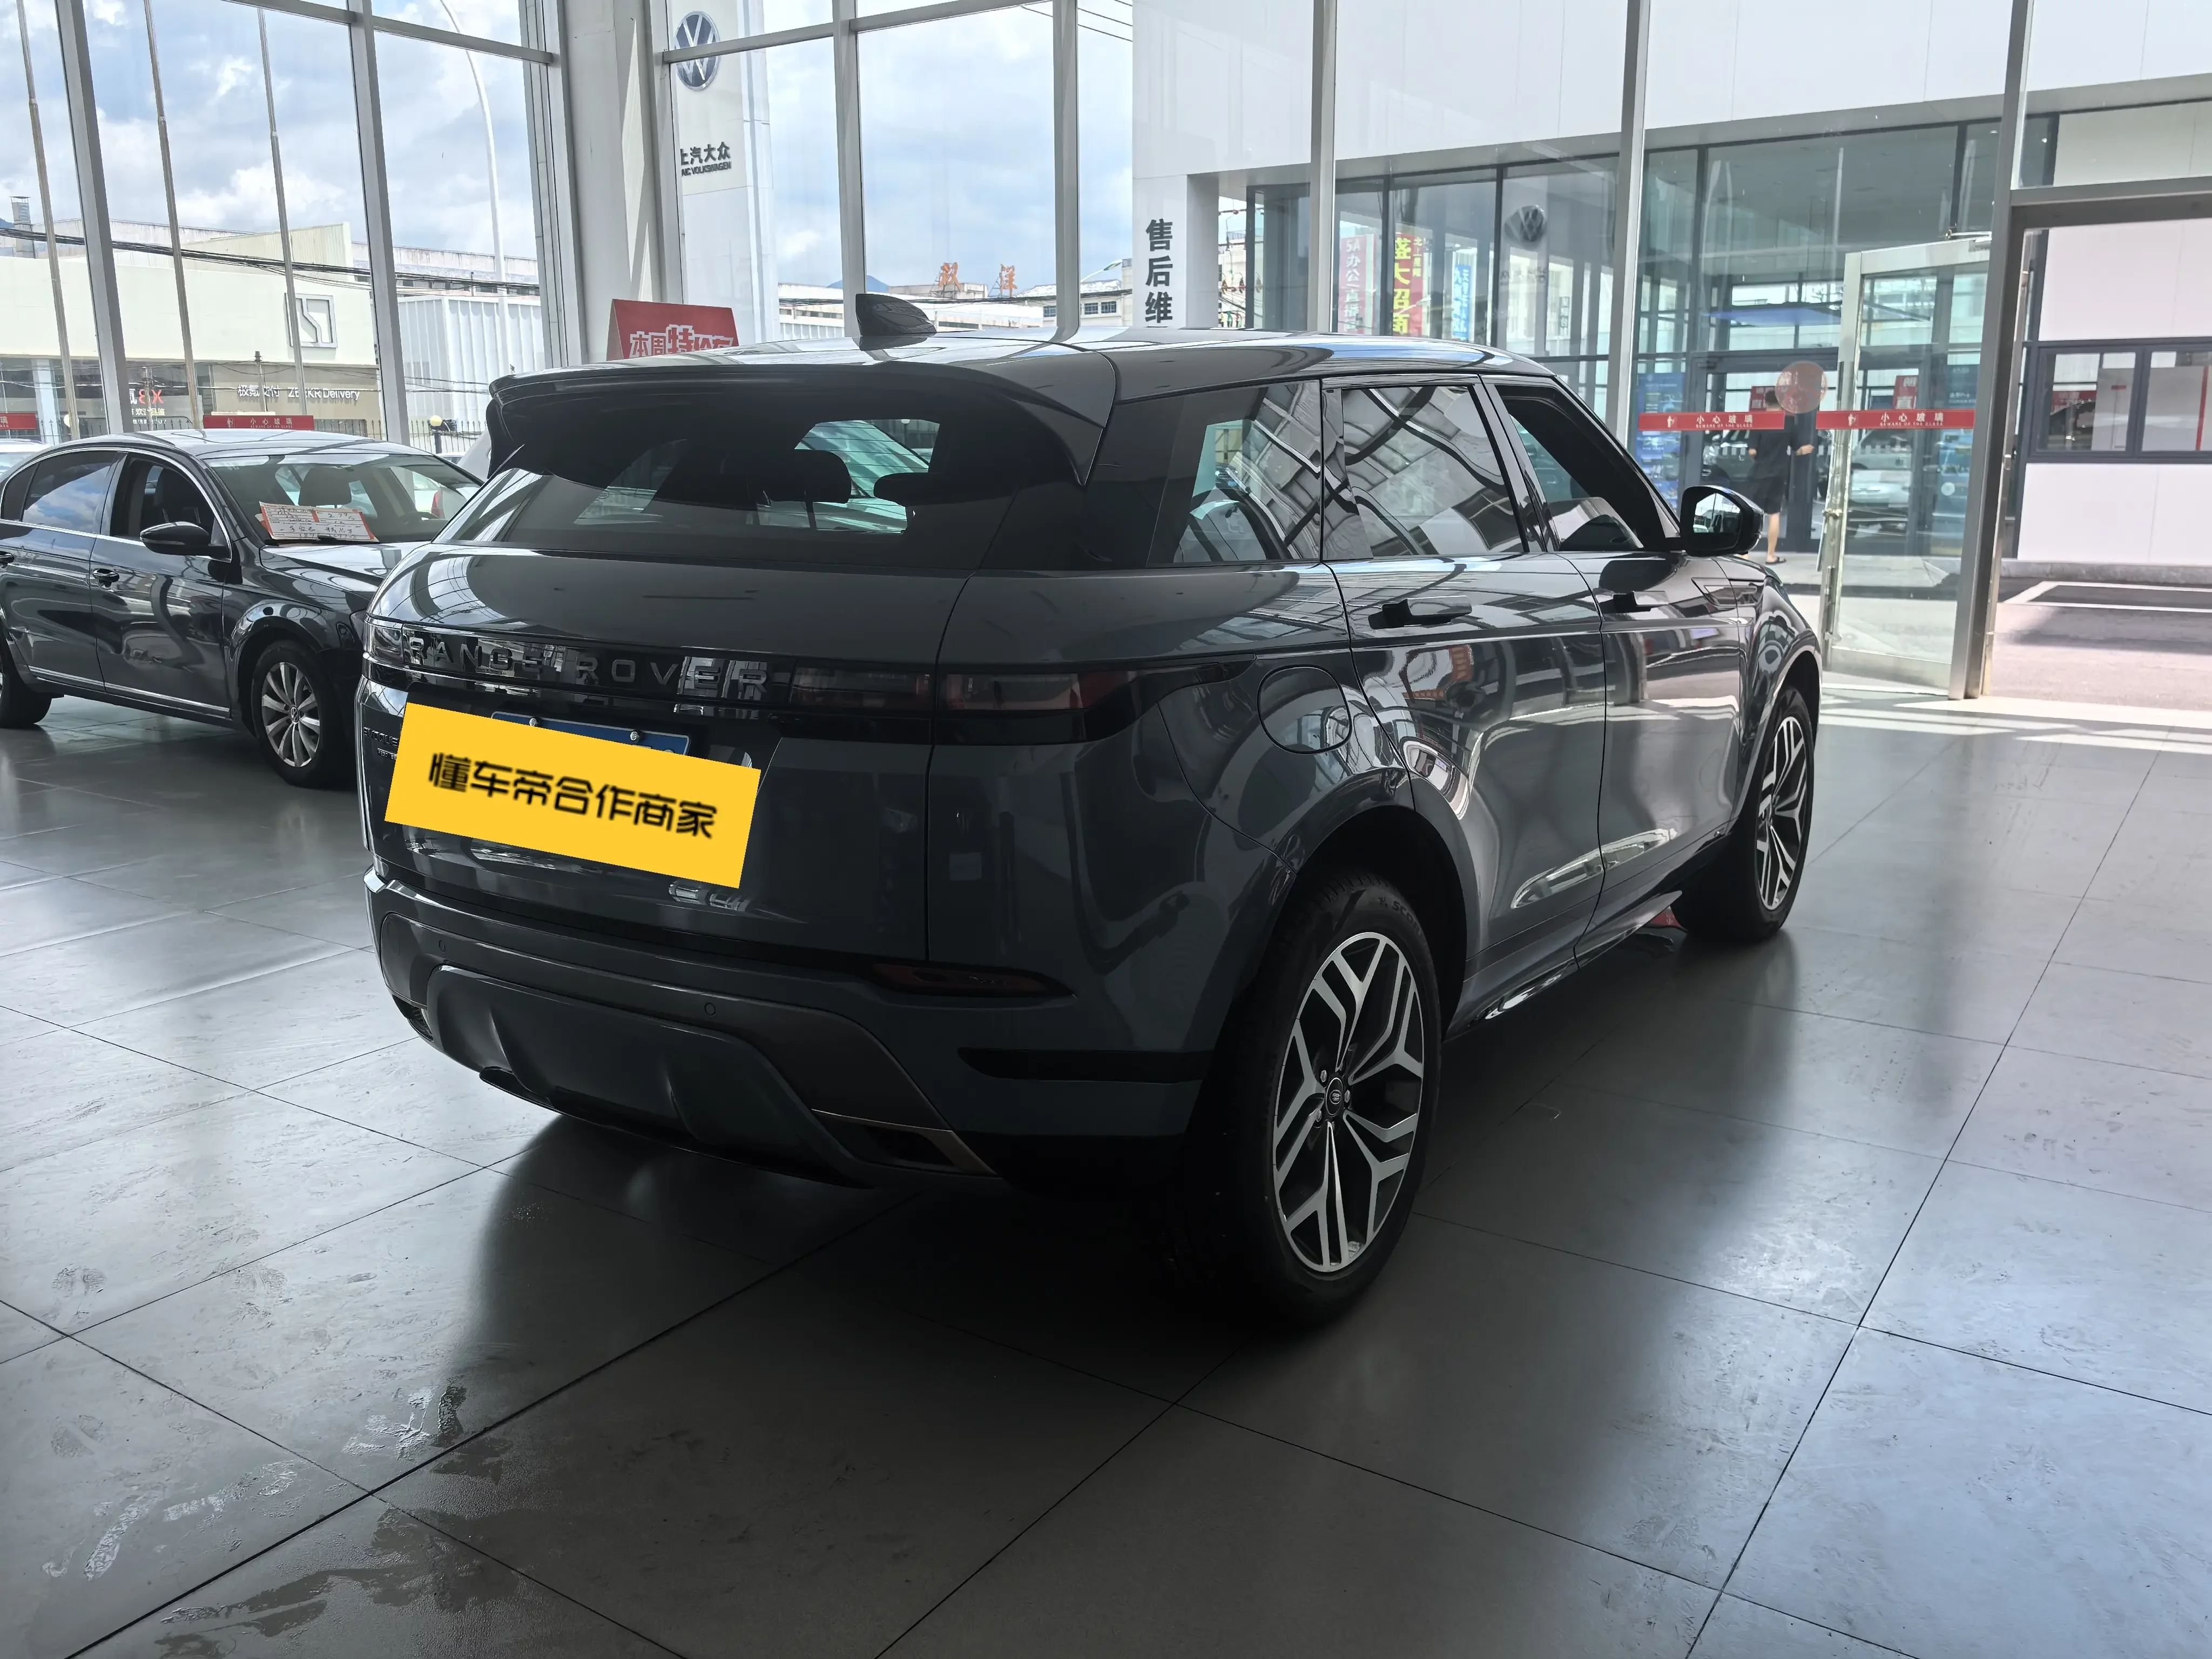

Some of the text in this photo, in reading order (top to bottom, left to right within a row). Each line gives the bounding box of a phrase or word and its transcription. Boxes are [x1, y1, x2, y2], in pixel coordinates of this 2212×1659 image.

[680, 141, 731, 165] 上汽大众
[287, 387, 360, 401] ZEKR Delivery
[251, 417, 293, 426] 小心玻璃
[1696, 414, 1753, 424] 小心玻璃
[1880, 412, 1944, 422] 小心玻璃
[409, 636, 767, 700] RANGE ROVER
